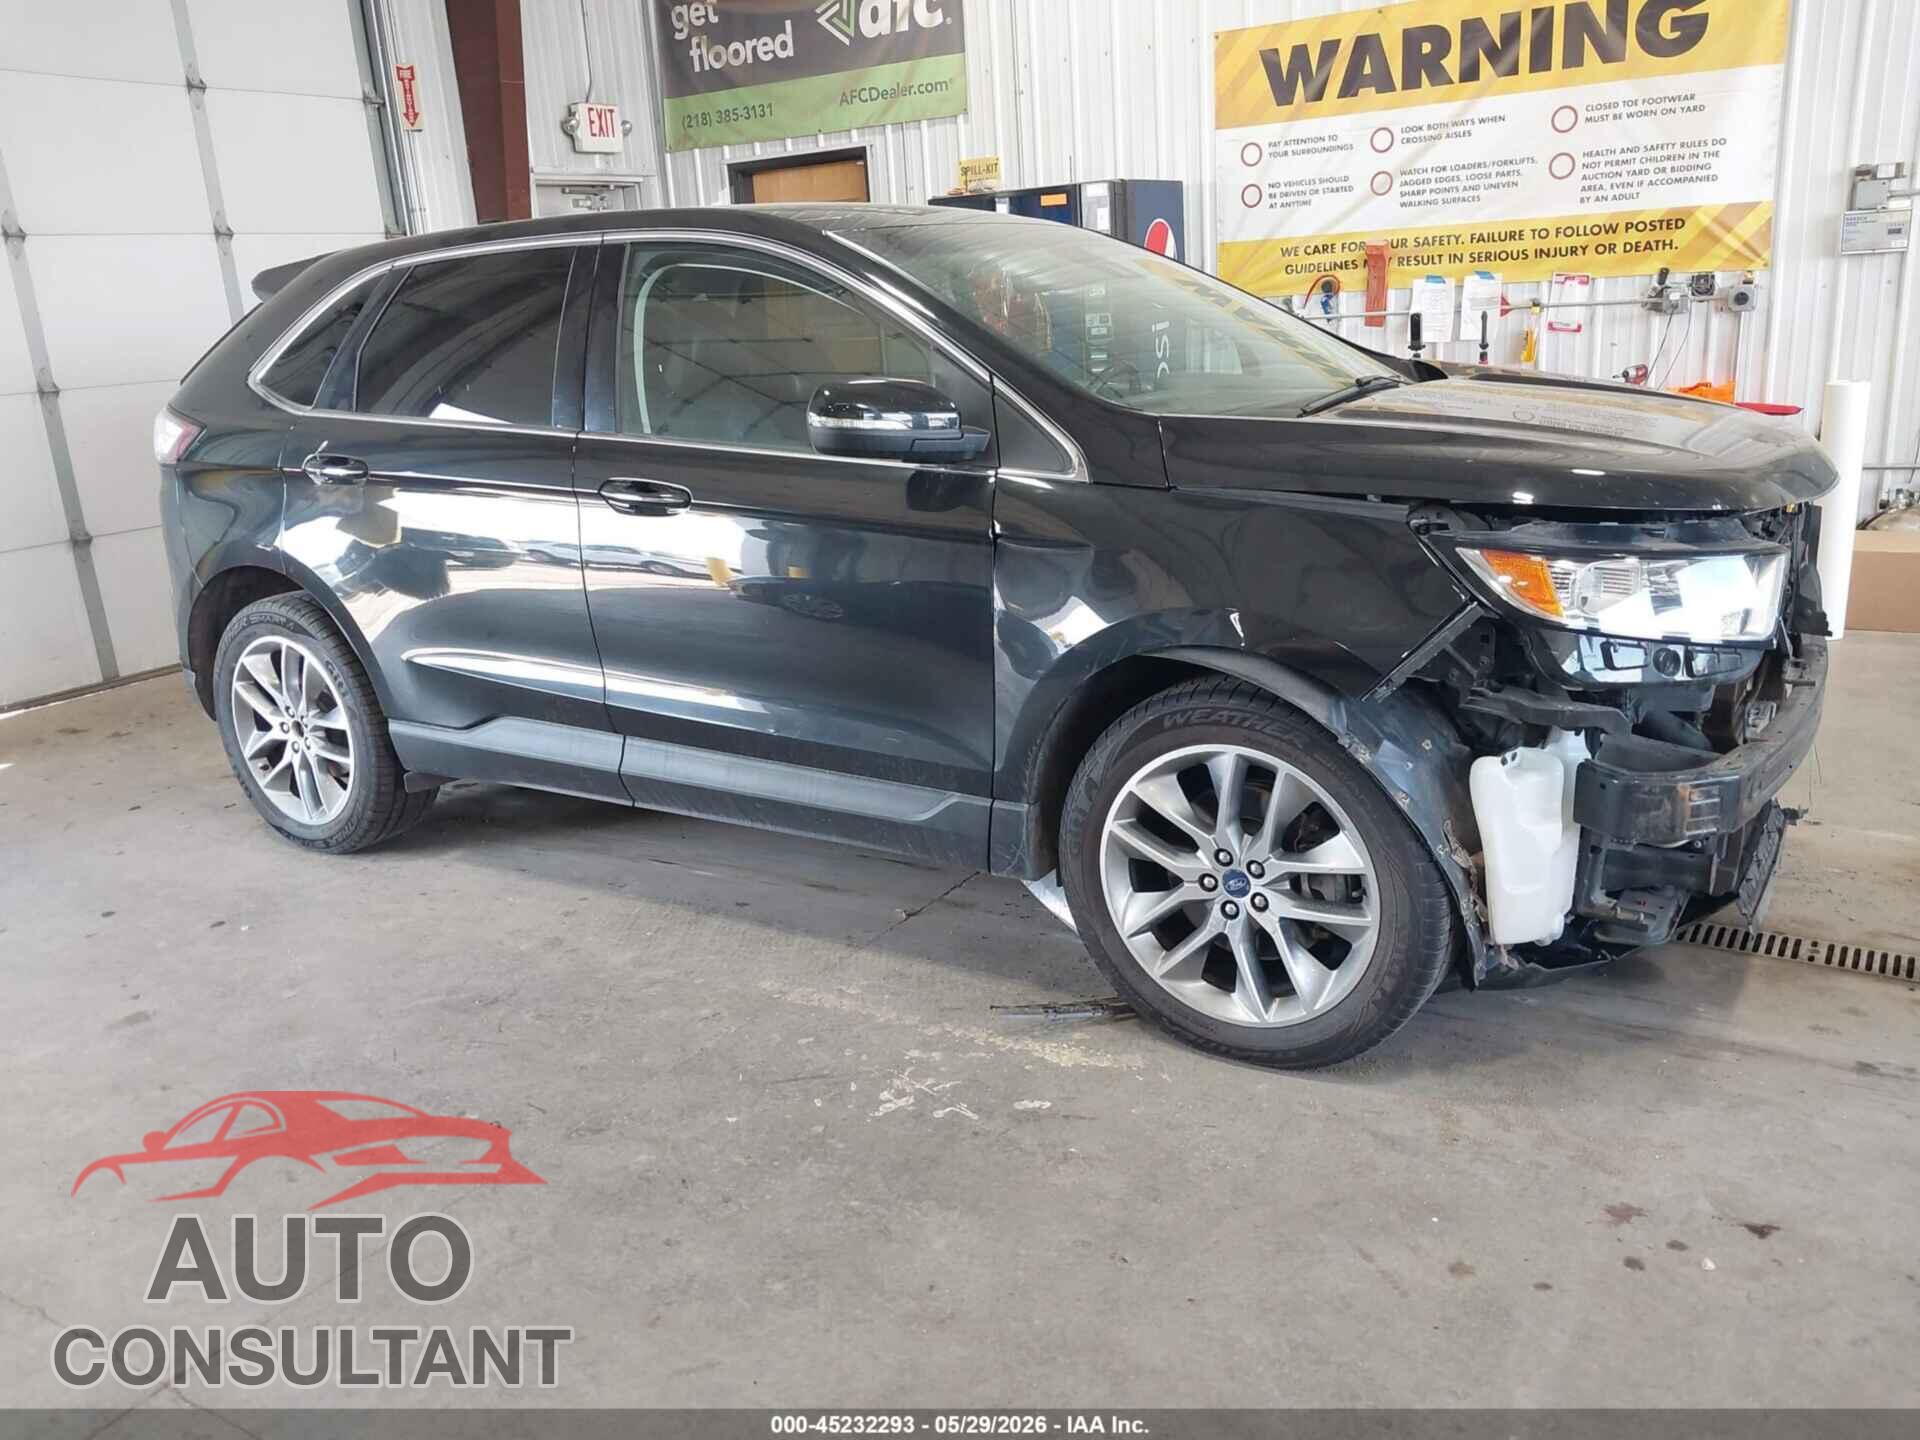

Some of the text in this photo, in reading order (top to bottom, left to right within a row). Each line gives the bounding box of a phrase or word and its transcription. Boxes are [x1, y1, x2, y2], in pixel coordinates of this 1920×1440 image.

[672, 0, 719, 40] get
[690, 20, 794, 72] floored
[1259, 0, 1710, 107] WARNING
[1585, 93, 1696, 112] CLOSED TOE FOOTWEAR
[588, 108, 615, 138] EXIT
[682, 102, 773, 128] (218) 385-3131
[1585, 104, 1705, 124] MUST BE WORN ON YARD
[1401, 115, 1506, 134] LOOK BOTH WAYS WHEN
[1268, 140, 1281, 148] PAY
[1283, 136, 1326, 147] ATTENTION
[1401, 130, 1472, 145] CROSSING AISLES
[1268, 144, 1354, 159] YOUR SURROUNDINGS
[1583, 138, 1727, 158] HEALTH AND SAFETY RULES DO
[1582, 162, 1601, 170] NOT
[1604, 158, 1636, 167] PERMIT
[1640, 153, 1685, 165] CHILDREN
[1703, 150, 1720, 158] THE
[1400, 167, 1428, 176] WATCH
[1431, 165, 1447, 173] FOR
[1400, 178, 1432, 187] JAGGED
[1465, 172, 1492, 181] LOOSE
[1582, 162, 1711, 181] AUCTION YARD OR BIDDING
[1284, 179, 1317, 188] VEHICLES
[1318, 176, 1349, 184] SHOULD
[1400, 181, 1518, 198] SHARP POINTS AND UNEVEN
[1610, 181, 1634, 190] EVEN
[1648, 174, 1718, 187] ACCOMPANIED
[1279, 189, 1306, 199] DRIVEN
[1309, 188, 1319, 196] OR
[1322, 185, 1354, 195] STARTED
[1400, 195, 1481, 208] WALKING SURFACES
[1580, 192, 1640, 204] BY AN ADULT
[1280, 199, 1312, 208] ANYTIME
[1281, 218, 1685, 258] WE CARE FOR UR SAFETY. FAILURE TO FOLLOW POSTED
[1285, 259, 1359, 275] GUIDELINES
[1397, 253, 1443, 267] RESULT
[1448, 252, 1464, 263] IN
[1469, 248, 1529, 264] SERIOUS
[1534, 244, 1589, 260] INJURY
[1594, 242, 1617, 255] OR
[1623, 239, 1679, 254] DEATH.
